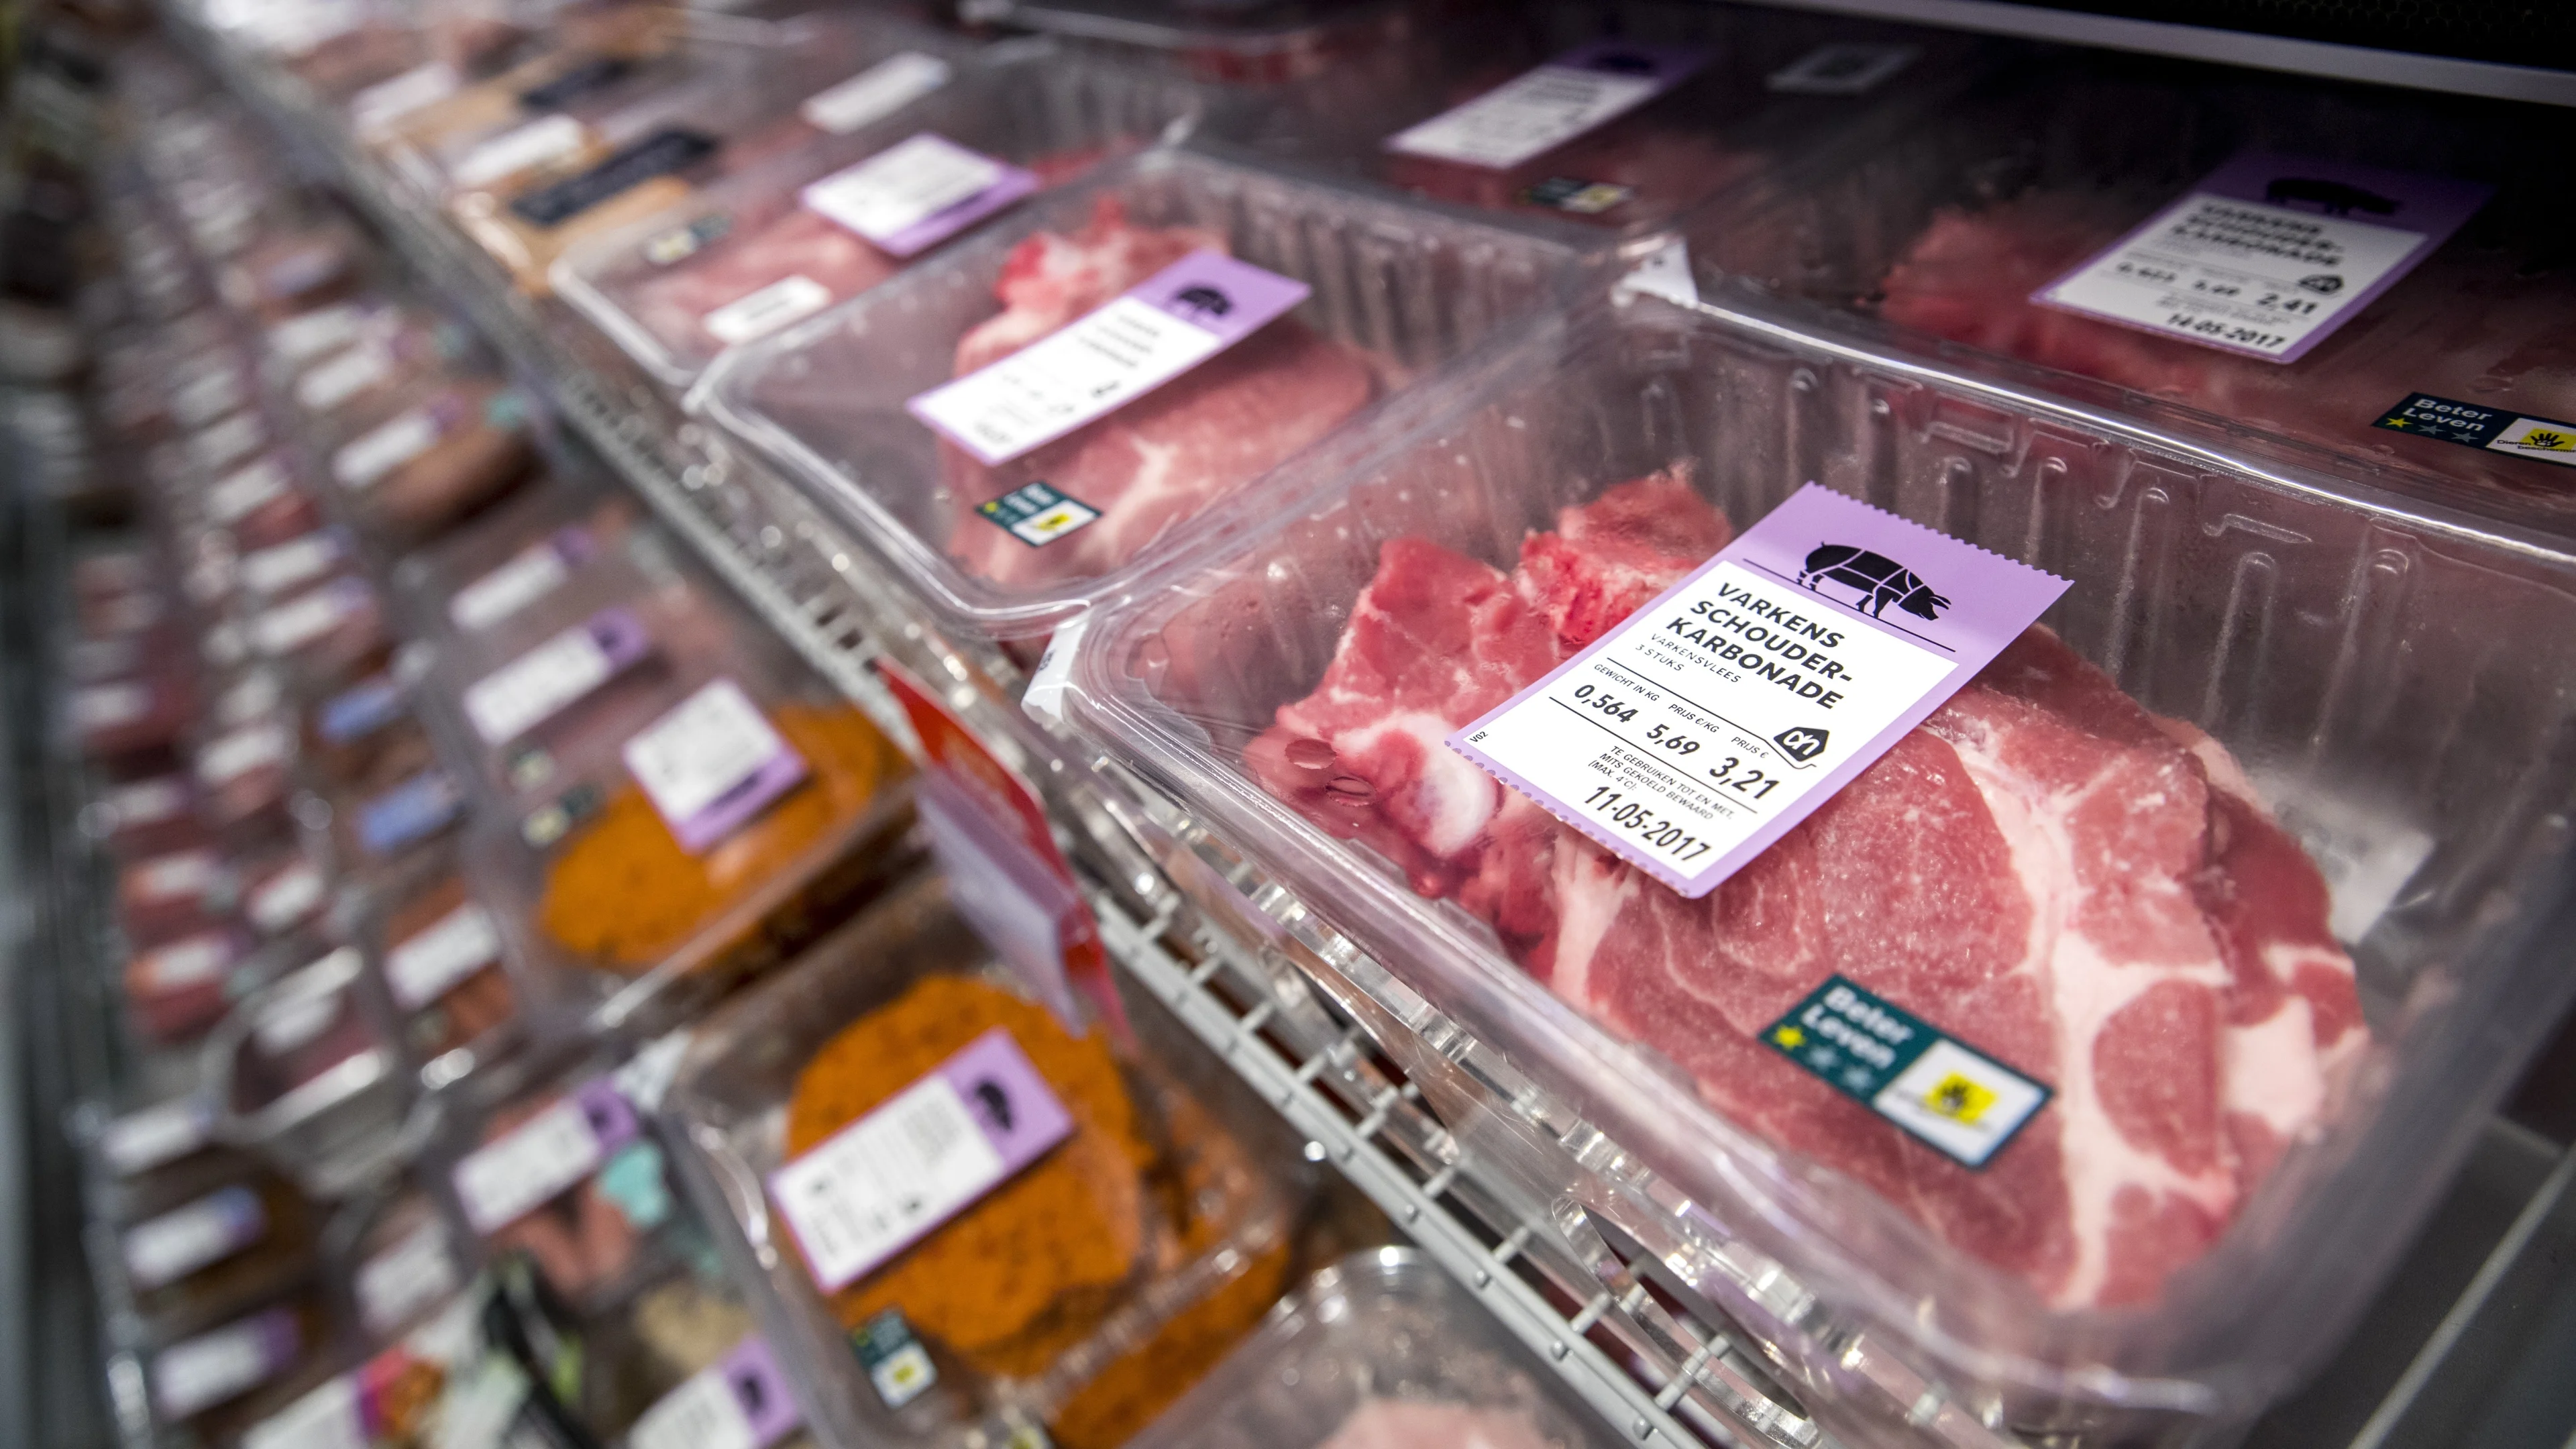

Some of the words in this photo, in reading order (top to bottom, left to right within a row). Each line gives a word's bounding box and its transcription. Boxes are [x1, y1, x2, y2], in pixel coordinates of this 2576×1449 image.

[2402, 408, 2485, 431] Leven
[2413, 398, 2493, 421] Beter
[1690, 600, 1852, 682] SCHOUDER-
[1718, 582, 1845, 647] VARKENS
[1594, 663, 1635, 687] GEWICHT
[1633, 684, 1644, 694] IN
[1645, 690, 1660, 702] KG
[1635, 643, 1644, 651] 3
[1645, 649, 1684, 672] STUKS
[1652, 633, 1741, 683] VARKENSVLEES
[1666, 616, 1844, 709] KARBONADE
[1574, 684, 1639, 723] 0,564
[1646, 723, 1701, 755] 5,69
[1709, 757, 1780, 800] 3,21
[1668, 703, 1696, 720] PRIJS
[1695, 717, 1719, 733] €/KG
[1731, 737, 1760, 754] PRIJS
[1599, 753, 1624, 769] MITS
[1623, 767, 1666, 793] GEKOELD
[1666, 791, 1714, 820] BEWAARD
[1610, 745, 1624, 756] TE
[1623, 754, 1676, 786] GEBRUIKEN
[1676, 783, 1697, 796] TOT
[1695, 794, 1712, 805] EN
[1585, 786, 1711, 861] 11-05-2017
